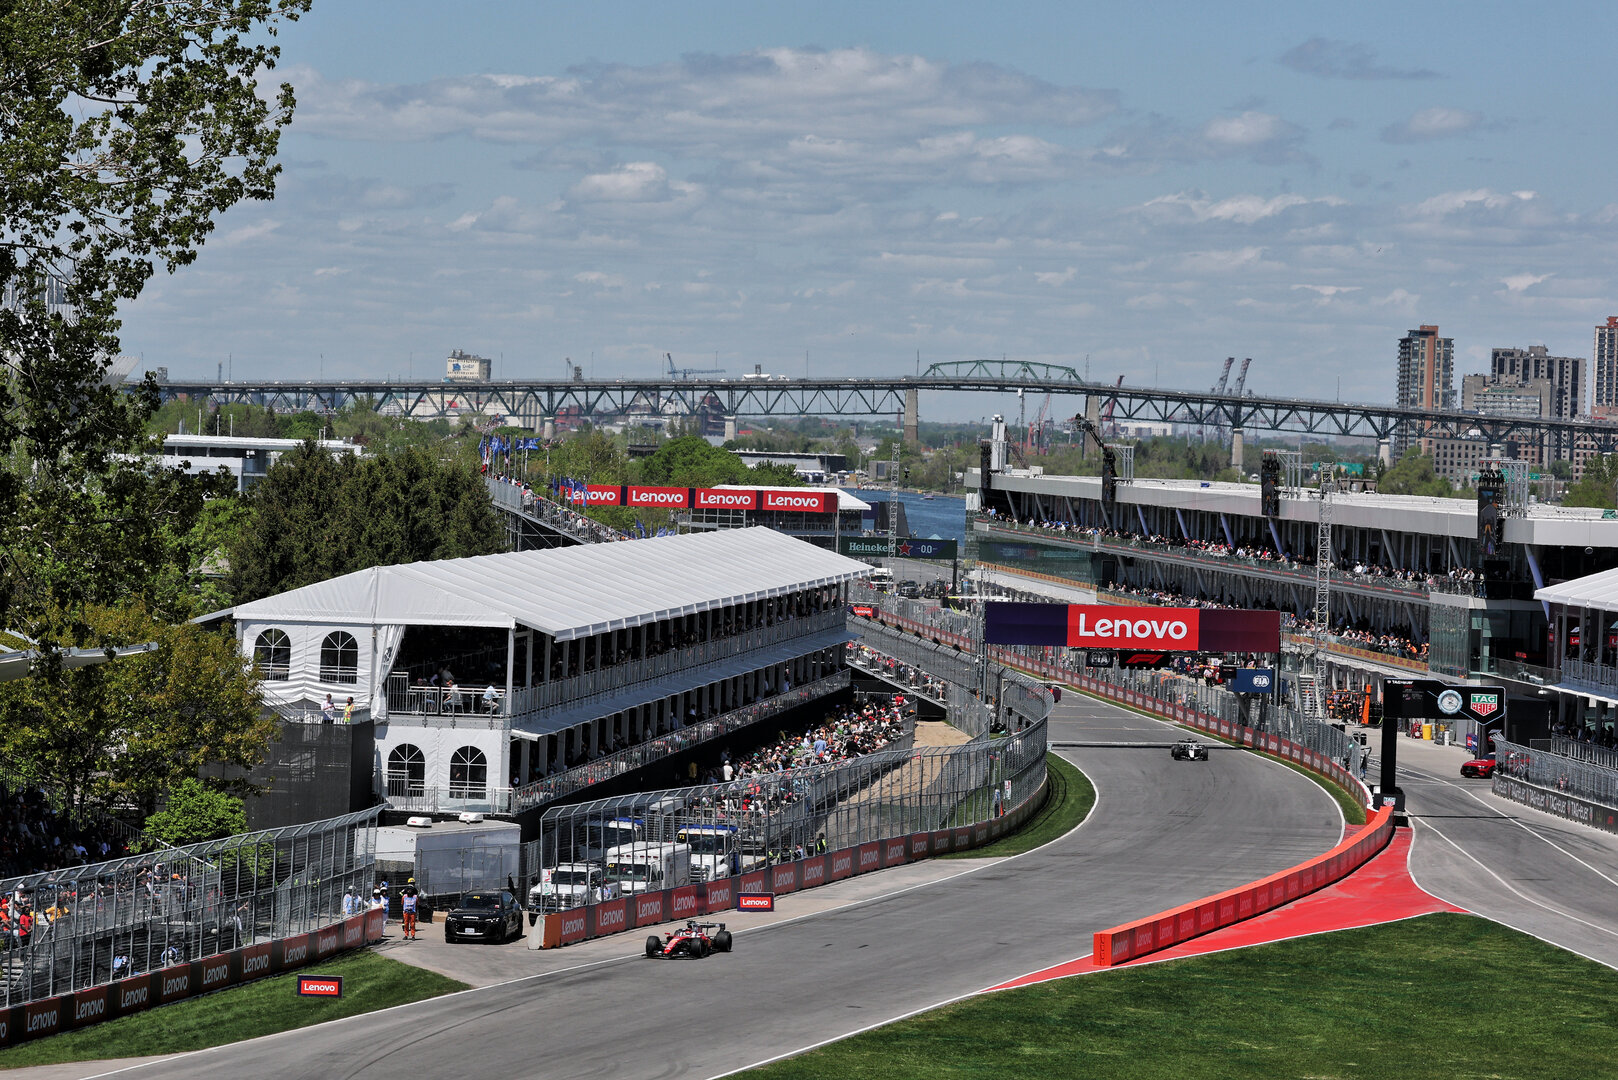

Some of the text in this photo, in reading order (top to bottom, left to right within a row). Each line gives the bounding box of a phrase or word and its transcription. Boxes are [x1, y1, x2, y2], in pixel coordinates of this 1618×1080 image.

[632, 490, 684, 503] Lenovo
[700, 492, 751, 505] Lenovo
[767, 493, 819, 508] Lenovo
[849, 542, 895, 552] Heineken
[1078, 613, 1188, 640] Lenovo
[1253, 677, 1269, 685] FIA
[1472, 703, 1497, 715] HEUER
[887, 844, 904, 859] Lenovo
[912, 840, 927, 853] Lenovo
[833, 857, 850, 873] Lenovo
[860, 849, 878, 866] Lenovo
[775, 871, 794, 887] Lenovo
[804, 864, 823, 881] Lenovo
[741, 880, 763, 892] Lenovo
[673, 895, 696, 912] Lenovo
[708, 887, 729, 905] Lenovo
[742, 898, 769, 906] Lenovo
[600, 907, 624, 926] Lenovo
[638, 899, 661, 918] Lenovo
[561, 917, 584, 936] Lenovo
[1160, 925, 1173, 940] Lenovo
[319, 935, 337, 954] Lenovo
[1112, 939, 1128, 957] Lenovo
[1136, 931, 1152, 948] Lenovo
[284, 945, 307, 964] Lenovo
[243, 954, 269, 973] Lenovo
[203, 964, 228, 985] Lenovo
[163, 975, 188, 996] Lenovo
[304, 983, 336, 992] Lenovo
[121, 986, 148, 1008] Lenovo
[75, 998, 105, 1020] Lenovo
[27, 1010, 58, 1032] Lenovo
